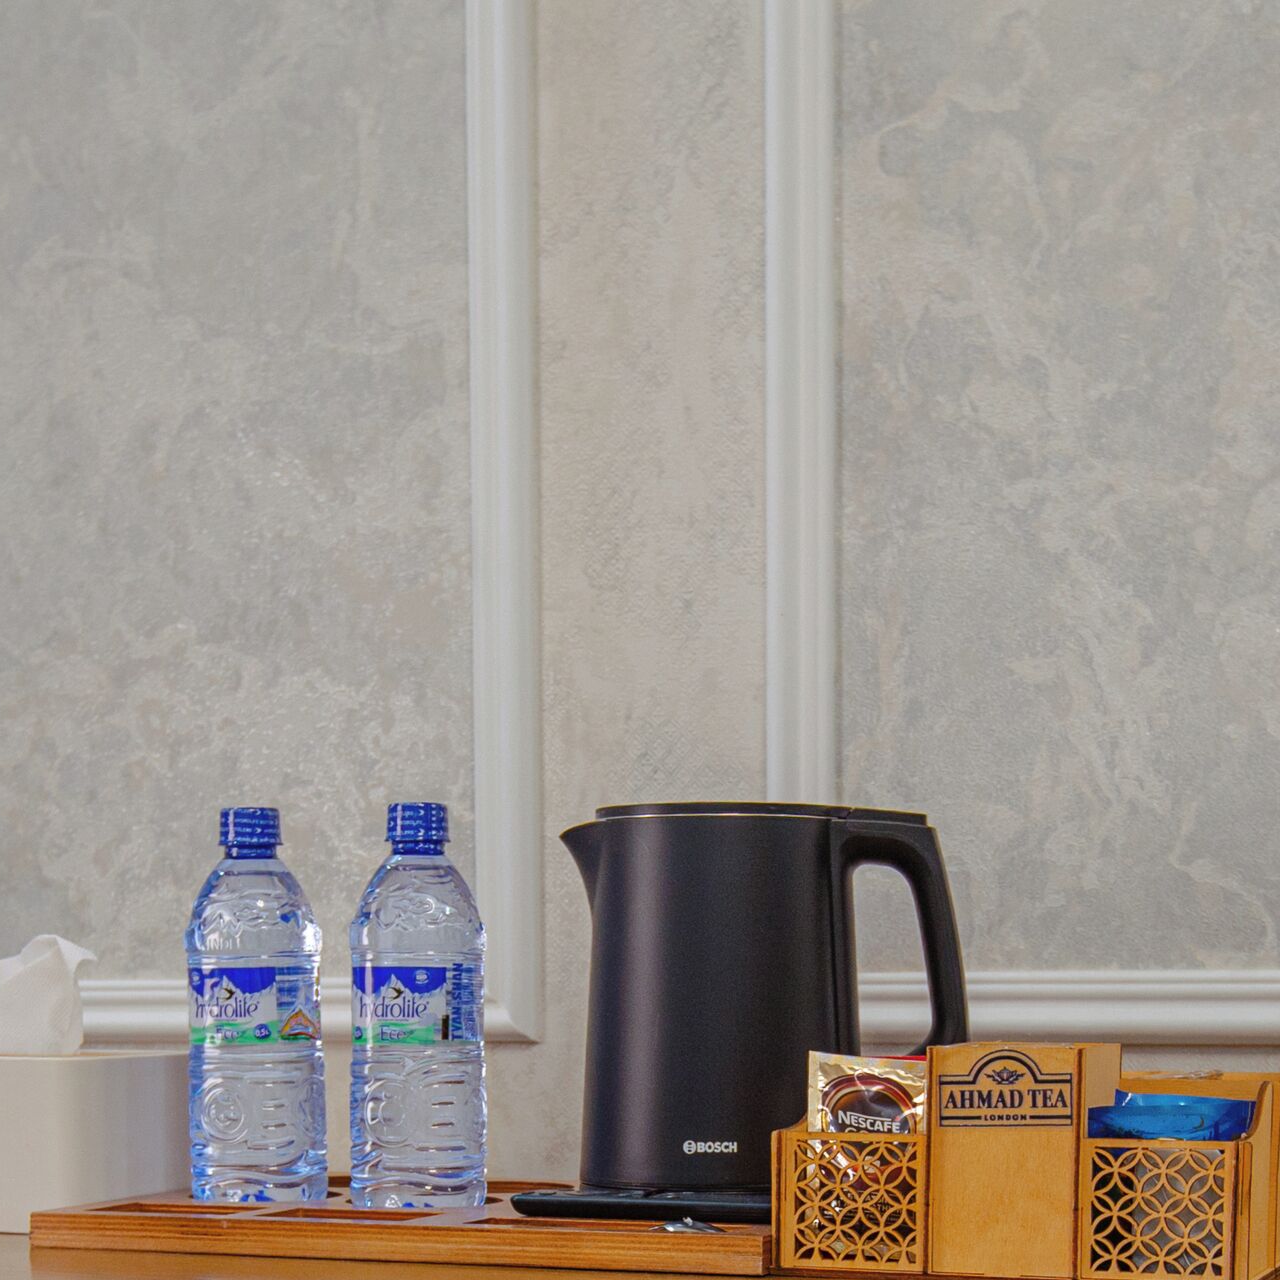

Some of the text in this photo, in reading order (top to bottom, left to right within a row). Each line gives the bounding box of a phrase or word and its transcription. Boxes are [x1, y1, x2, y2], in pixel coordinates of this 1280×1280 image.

[944, 1088, 1069, 1109] AHMAD TEA
[696, 1141, 738, 1153] BOSCH
